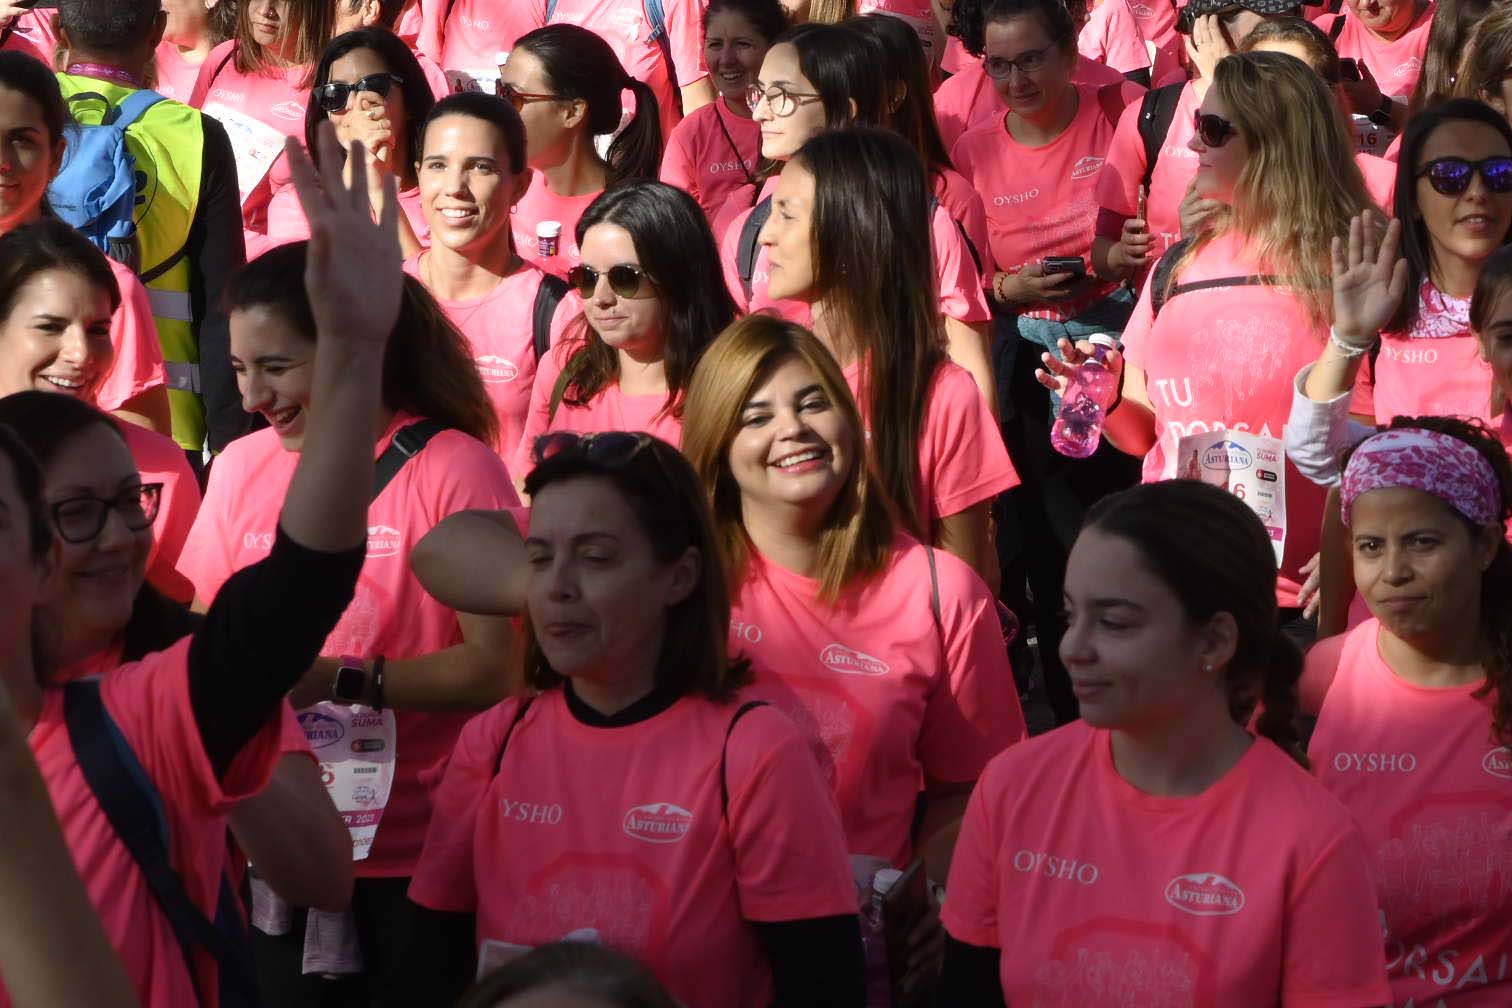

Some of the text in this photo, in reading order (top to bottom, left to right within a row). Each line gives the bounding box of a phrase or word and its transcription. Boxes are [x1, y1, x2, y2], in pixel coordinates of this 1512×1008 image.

[993, 188, 1040, 207] OYSHO
[1156, 377, 1193, 407] TU
[1204, 452, 1249, 466] ASTURIANA
[1256, 452, 1277, 463] SUMA
[825, 648, 887, 673] ASTURIANA
[351, 717, 384, 728] SUMA
[1334, 752, 1417, 774] OYSHO
[1013, 849, 1099, 886] OYSHO
[1171, 884, 1238, 909] ASTURIANA
